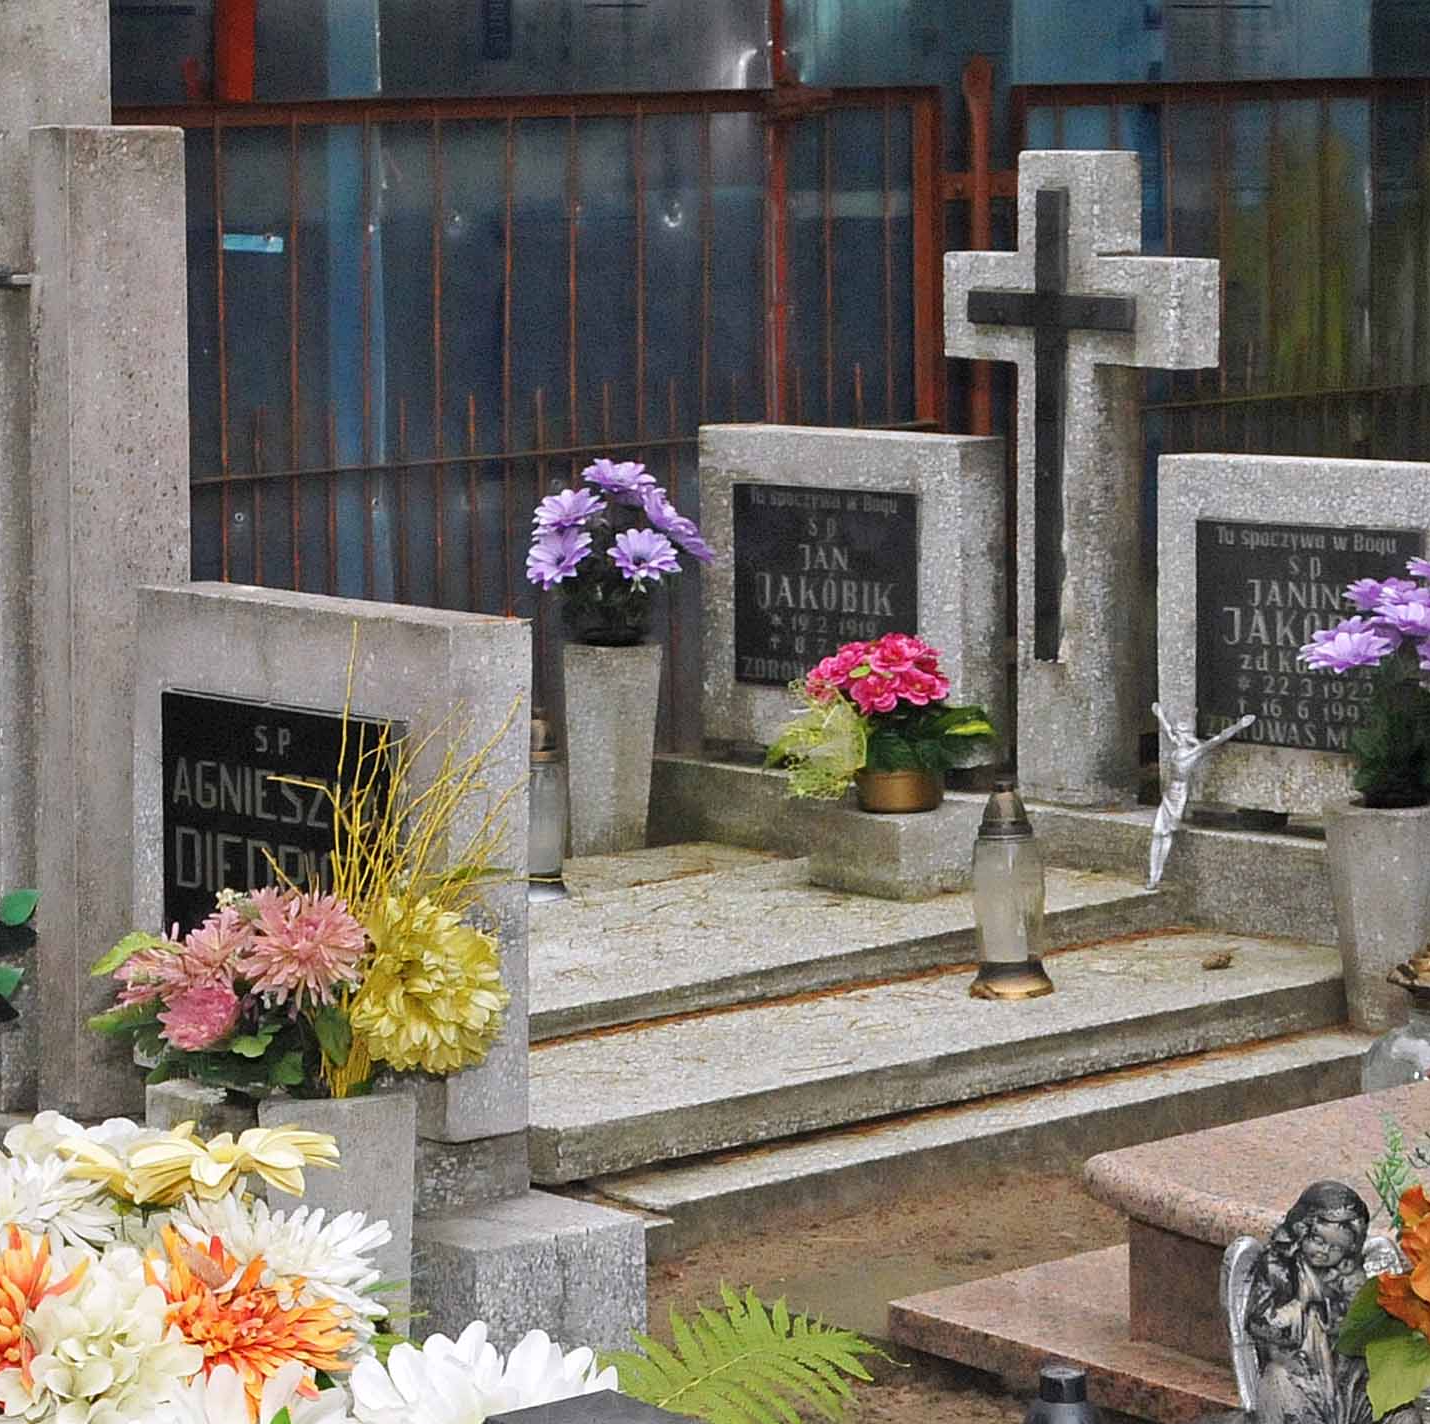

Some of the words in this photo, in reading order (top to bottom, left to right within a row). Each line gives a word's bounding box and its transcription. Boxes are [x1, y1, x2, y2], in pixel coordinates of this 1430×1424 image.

[798, 543, 850, 571] JAN
[1240, 528, 1326, 550] spoczywa
[1333, 535, 1348, 551] w
[1353, 532, 1397, 556] Bogu
[755, 571, 899, 617] JAKÓBIK
[1248, 578, 1353, 611] JANIN
